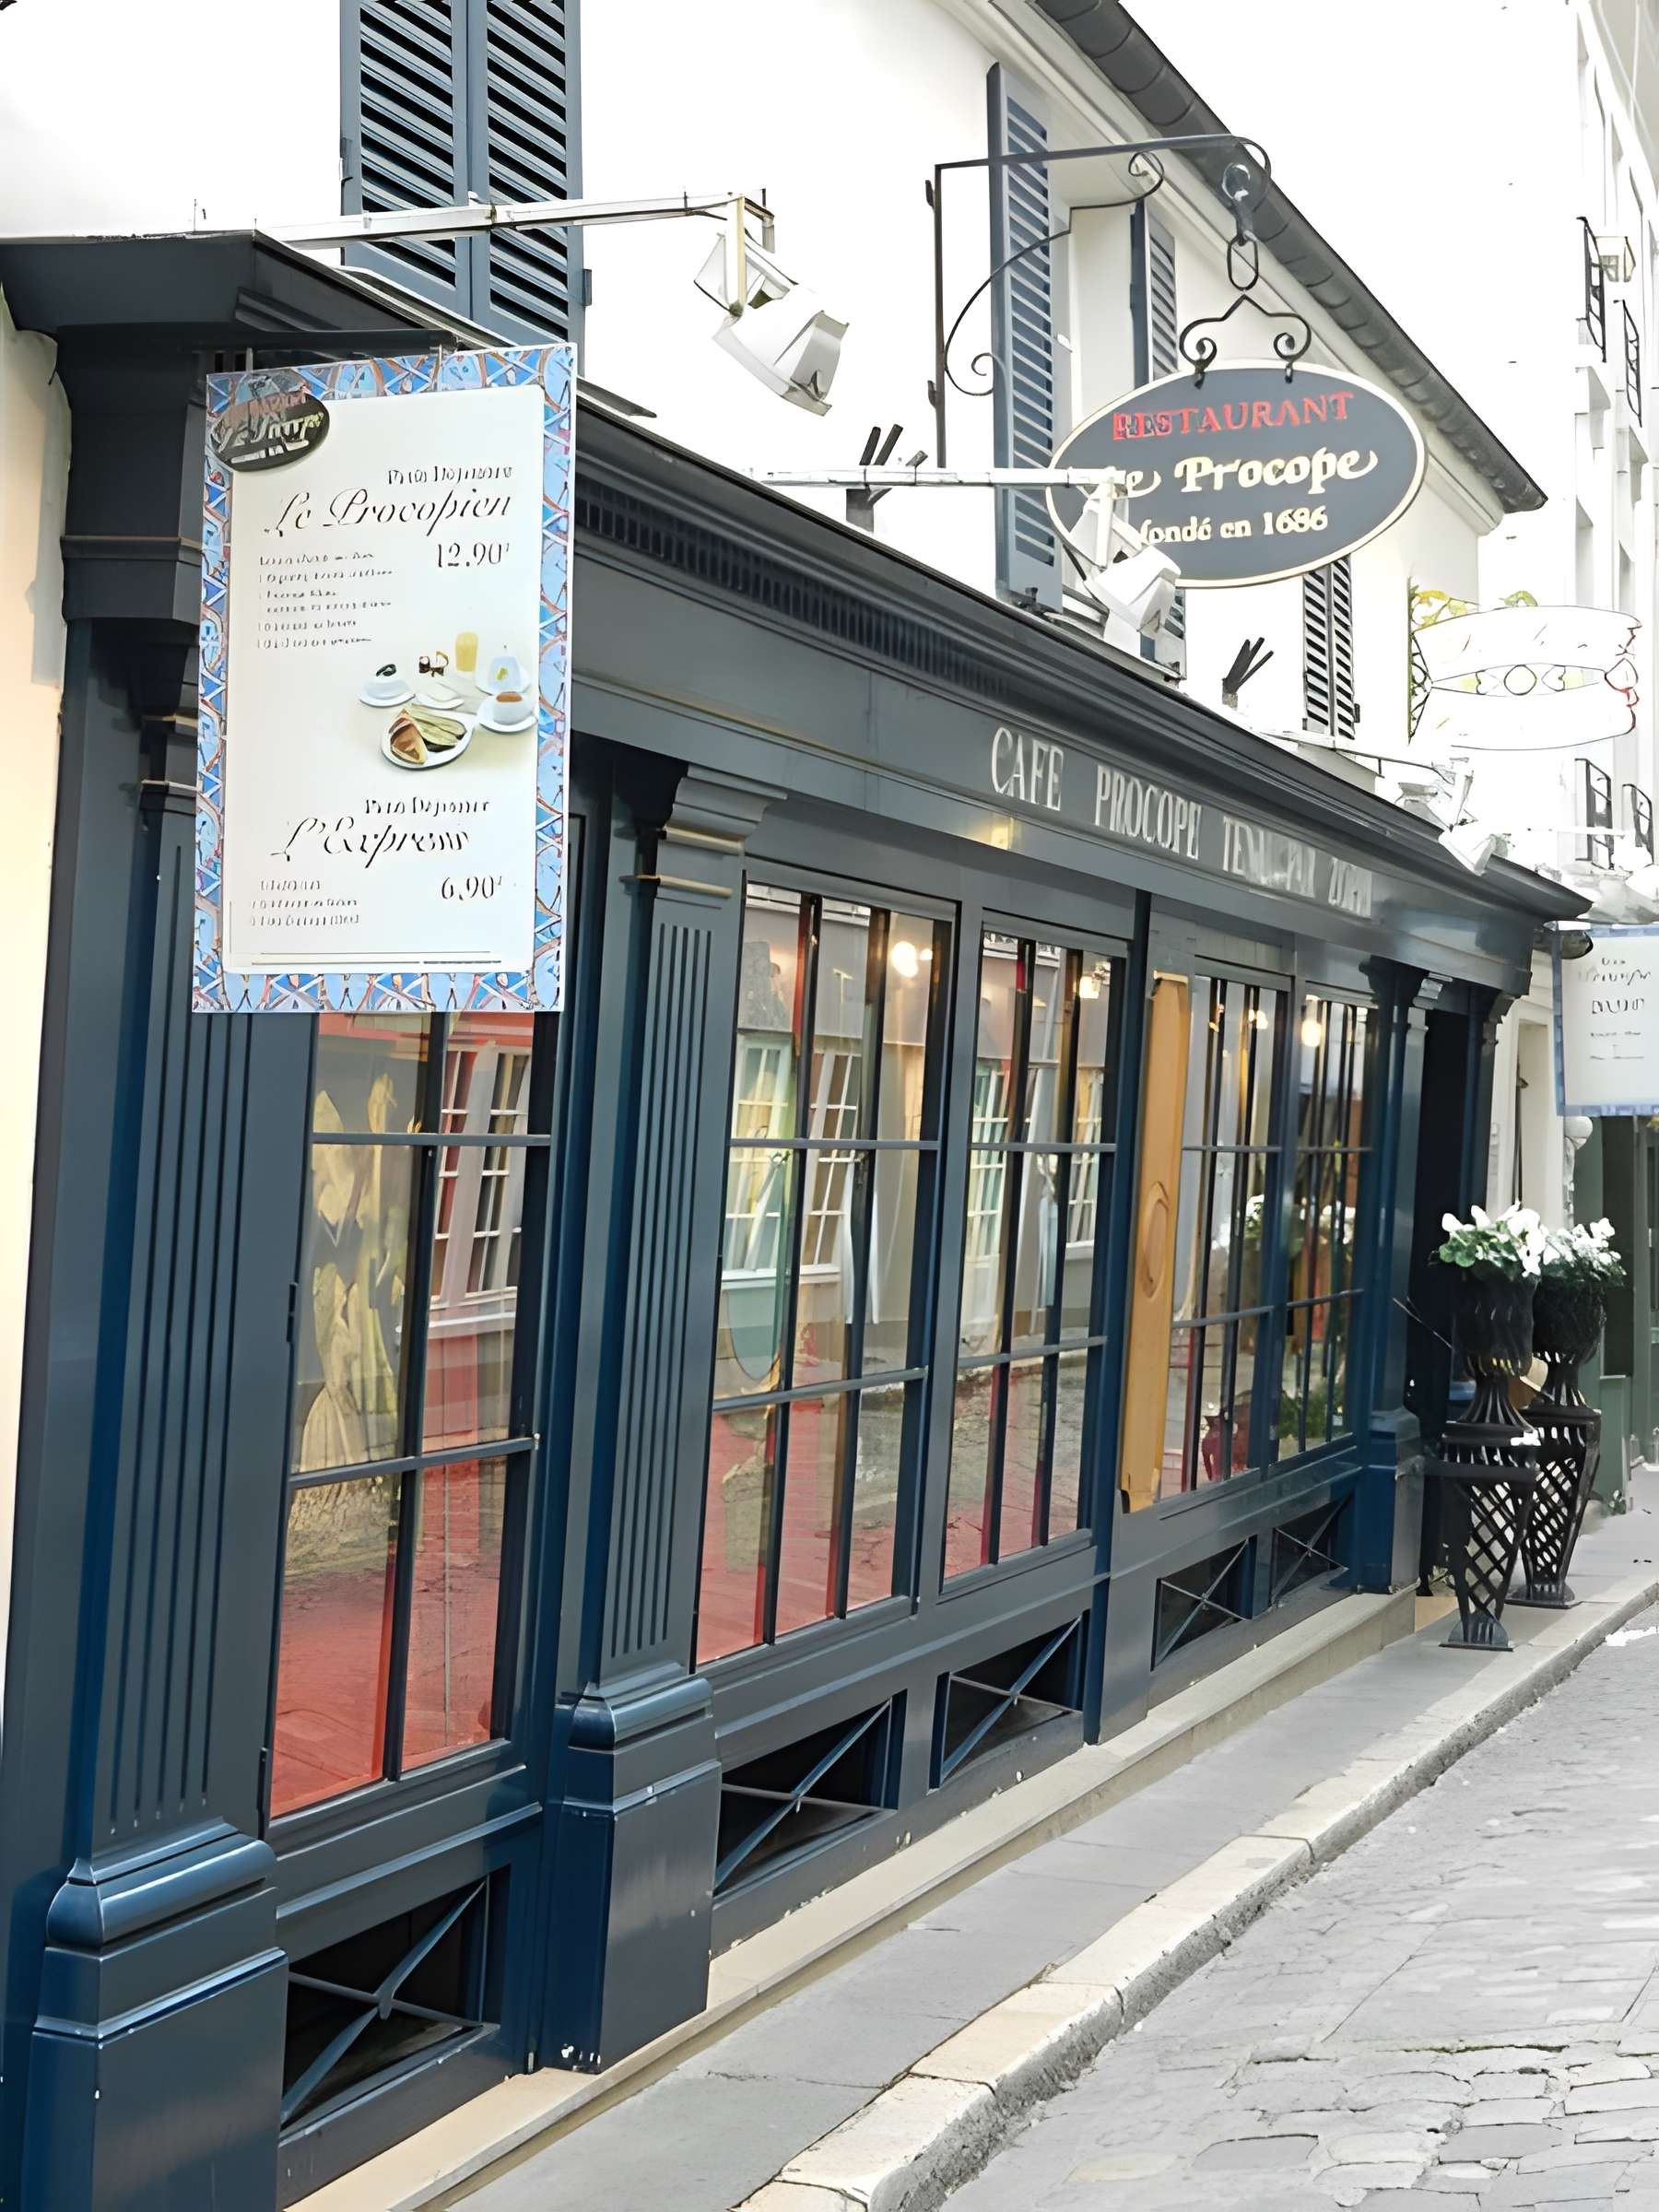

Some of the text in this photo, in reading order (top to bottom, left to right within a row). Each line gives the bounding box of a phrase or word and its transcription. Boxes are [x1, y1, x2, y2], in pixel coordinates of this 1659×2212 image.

[1112, 391, 1354, 441] RESTAURANT
[1174, 447, 1379, 494] Procope
[264, 488, 511, 537] Le Procopien
[1219, 520, 1252, 539] en
[1263, 505, 1328, 535] 1686
[991, 726, 1064, 811] CAFE
[1095, 764, 1202, 860] PROCOPE
